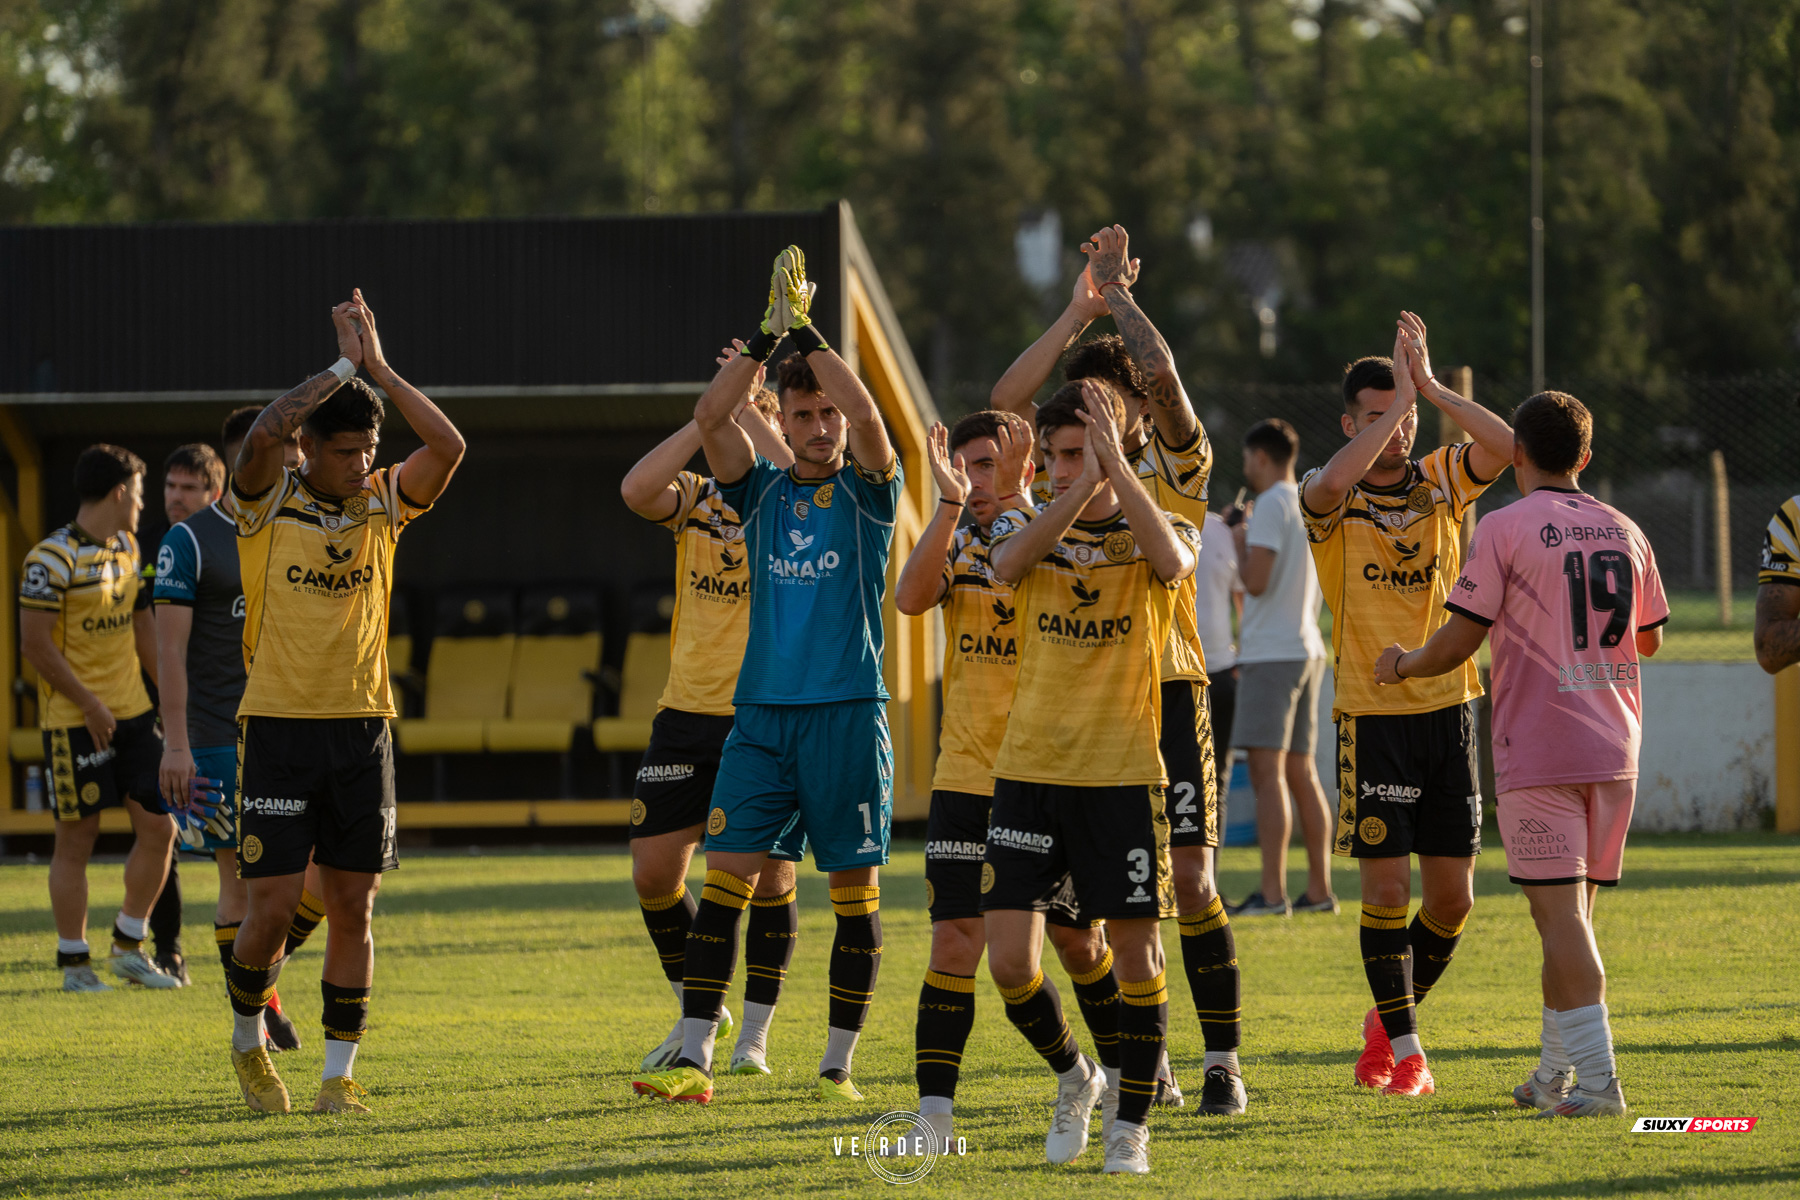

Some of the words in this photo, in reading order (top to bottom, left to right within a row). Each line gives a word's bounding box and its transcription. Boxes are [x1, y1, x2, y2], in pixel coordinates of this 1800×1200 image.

[287, 565, 373, 592] CANARO
[304, 587, 331, 598] TEXTILE
[695, 593, 720, 604] TEXTILE
[1563, 550, 1632, 652] 19
[1038, 612, 1132, 640] CANARIO
[1048, 636, 1076, 648] TEXTILE
[1559, 662, 1638, 684] NORDELEC
[641, 764, 694, 777] CANARIO
[1173, 781, 1197, 814] 2
[379, 806, 397, 839] 18
[858, 802, 872, 834] 1
[927, 840, 986, 855] CANARIO
[992, 826, 1053, 848] CANARIO
[1000, 840, 1020, 850] TEXTILE
[1511, 833, 1566, 846] RICARDO
[1511, 845, 1570, 856] CANIGLIA
[1127, 848, 1150, 883] 3
